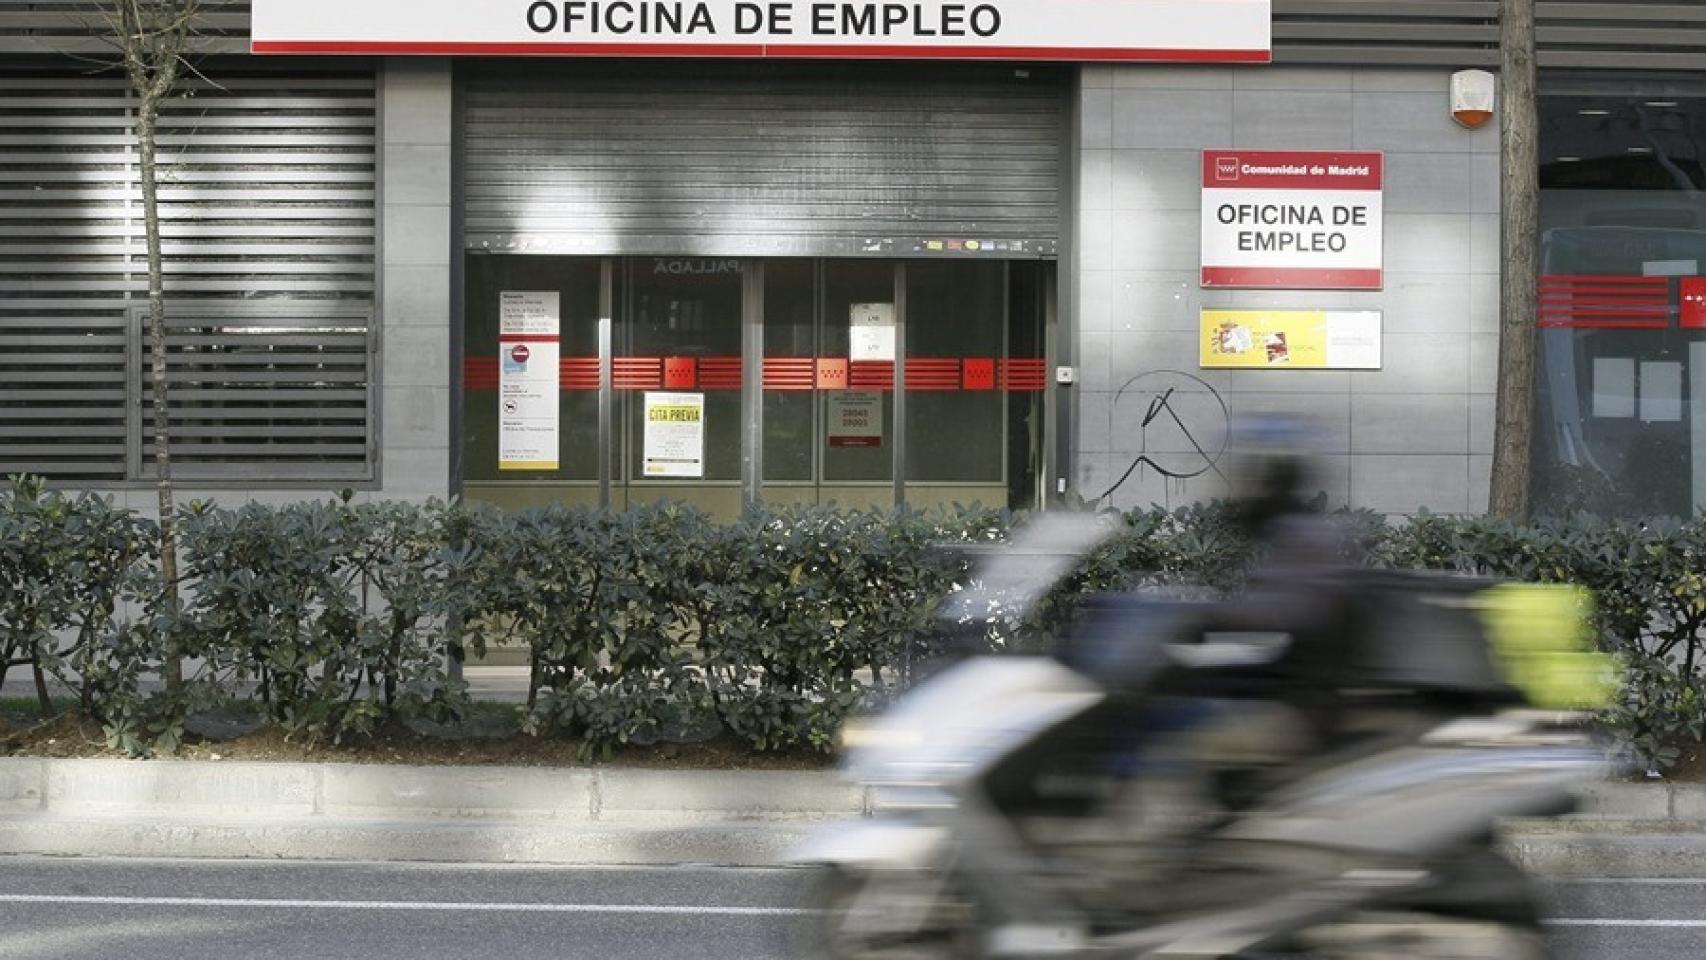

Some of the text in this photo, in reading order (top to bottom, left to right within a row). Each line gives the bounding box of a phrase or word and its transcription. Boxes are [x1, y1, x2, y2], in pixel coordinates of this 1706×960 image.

[526, 1, 1001, 37] OFICINA DE EMPLEO
[1241, 164, 1370, 176] Comunidad de Madrid
[1217, 204, 1367, 226] OFICINA DE
[1238, 231, 1347, 252] EMPLEO
[649, 408, 699, 421] CITA PREVIA
